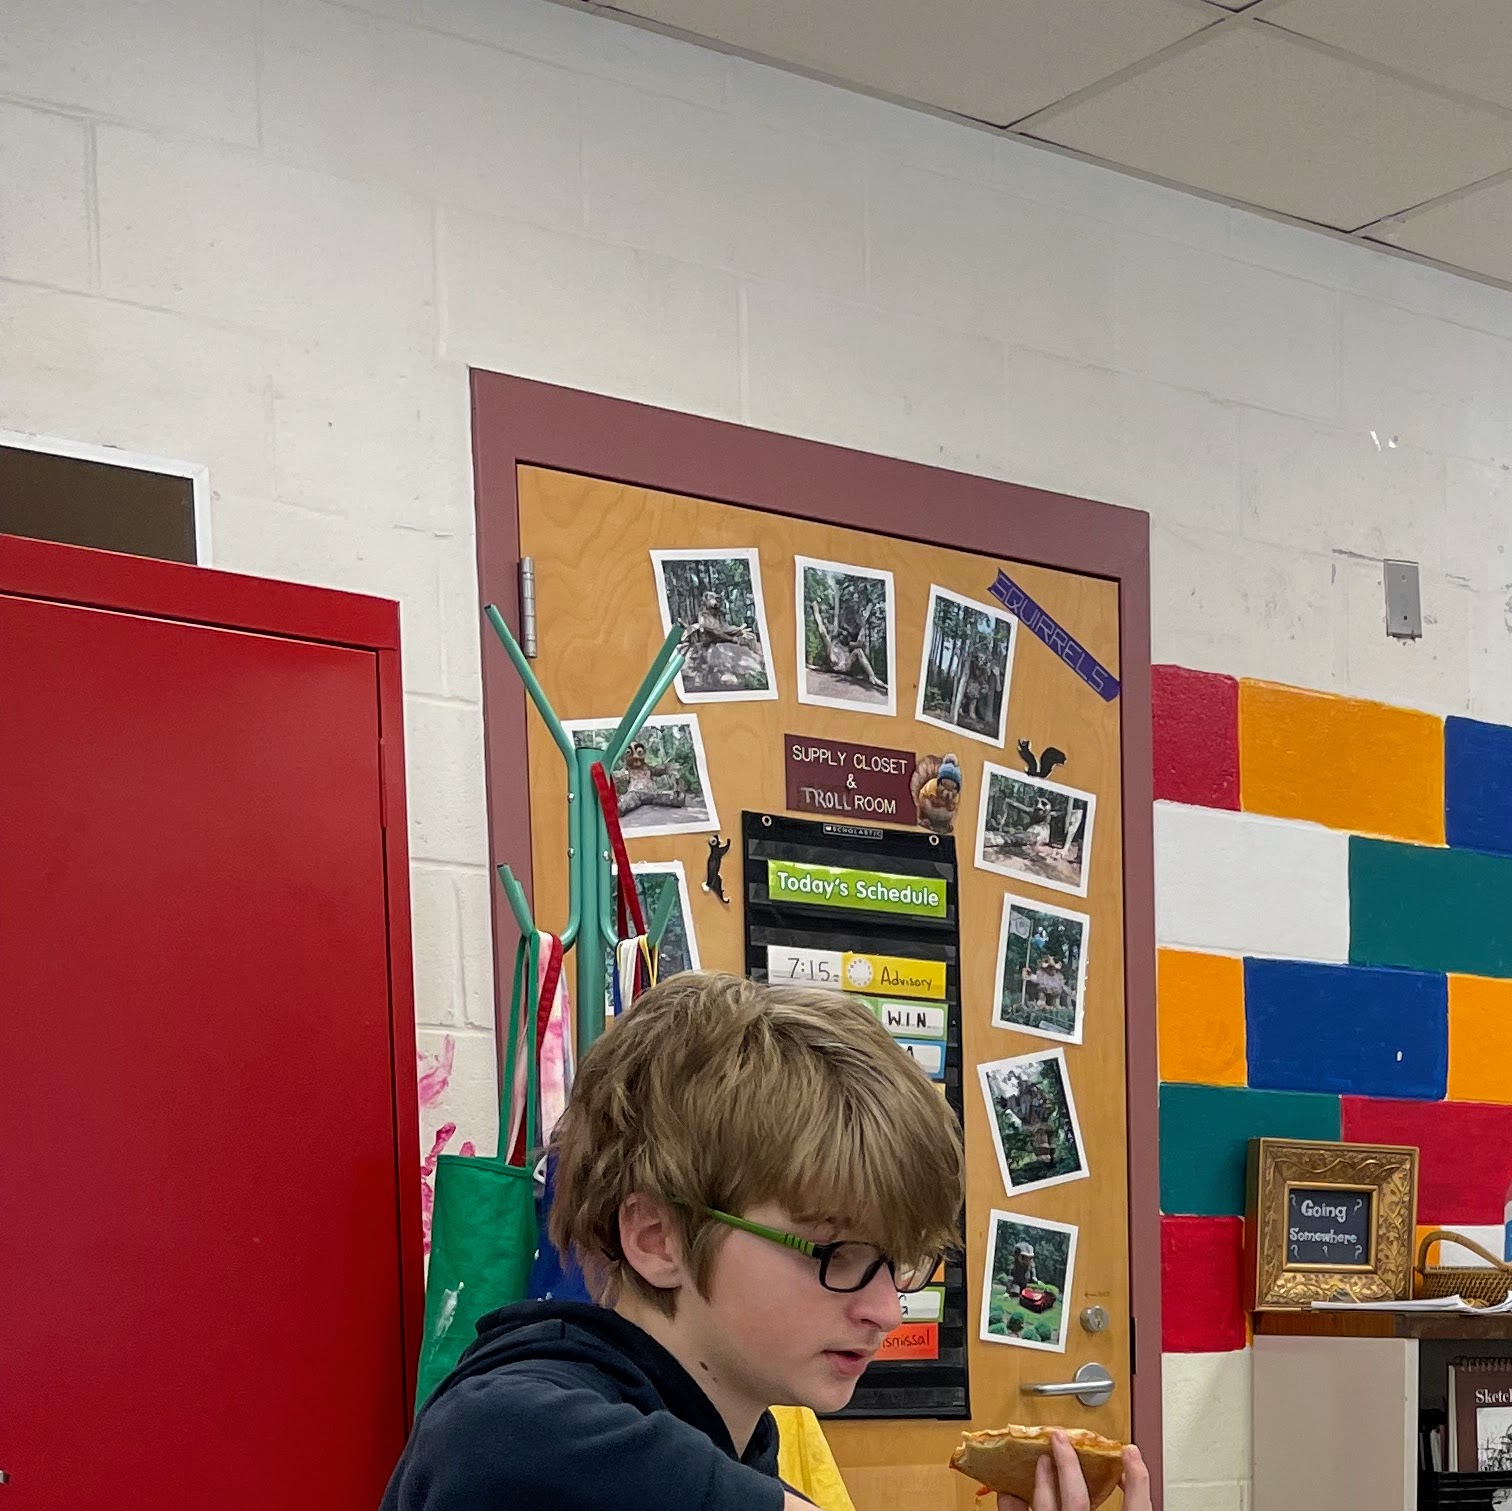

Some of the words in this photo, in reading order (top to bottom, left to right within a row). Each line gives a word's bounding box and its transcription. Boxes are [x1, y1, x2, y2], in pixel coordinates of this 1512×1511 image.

[990, 573, 1109, 693] SQUIRRELS
[792, 744, 847, 767] SUPPLY
[853, 753, 908, 775] CLOSET
[846, 773, 858, 789] &
[801, 787, 852, 811] TROLL
[854, 795, 896, 814] ROOM
[832, 825, 882, 838] SCHOLASTIC
[777, 871, 849, 900] Today's
[856, 881, 940, 907] Schedule
[881, 966, 932, 991] Advisory
[887, 1010, 927, 1028] WIN
[1300, 1200, 1347, 1223] Going
[1289, 1227, 1358, 1244] Somewhere
